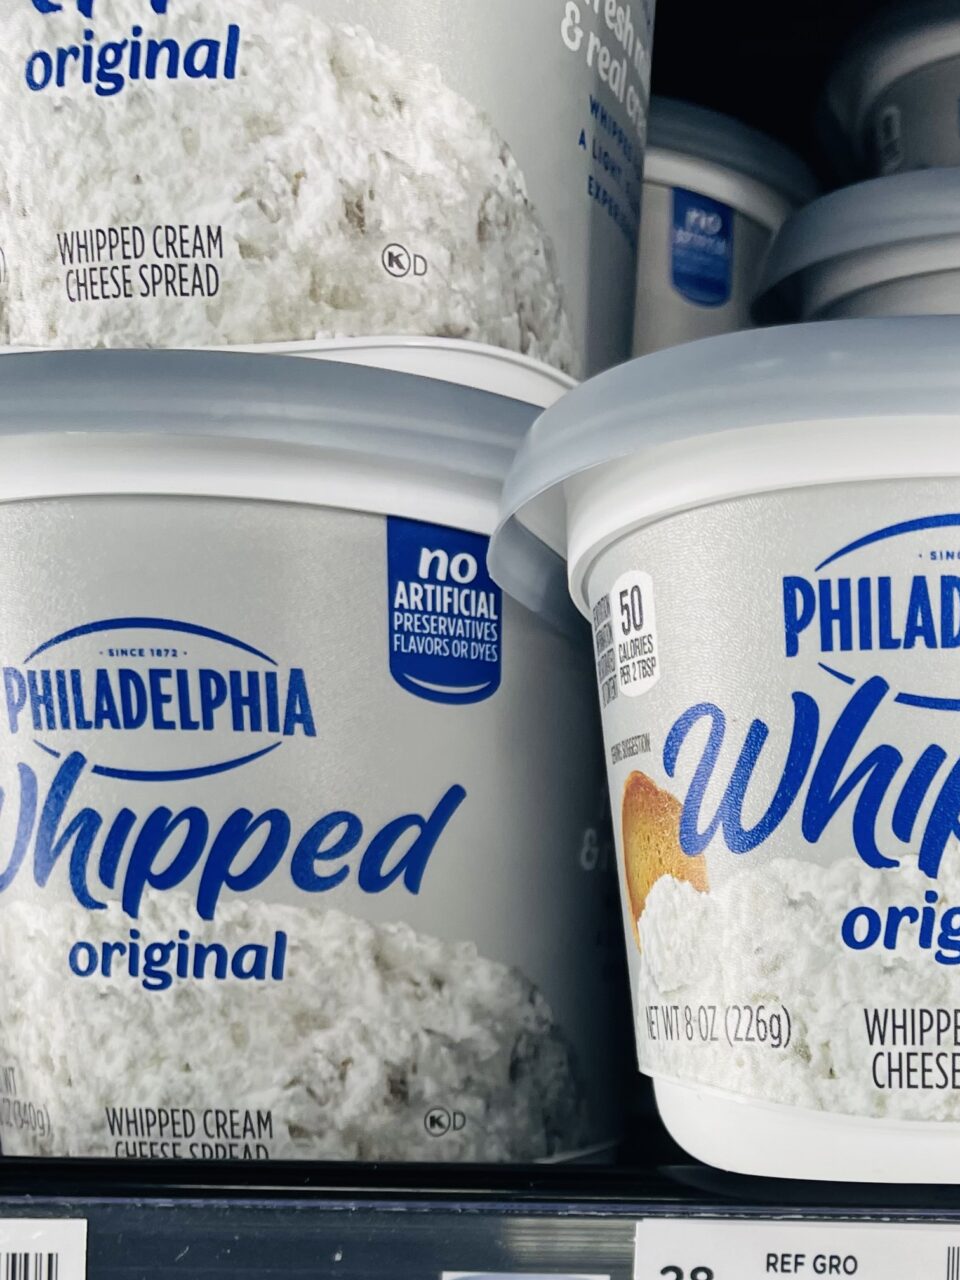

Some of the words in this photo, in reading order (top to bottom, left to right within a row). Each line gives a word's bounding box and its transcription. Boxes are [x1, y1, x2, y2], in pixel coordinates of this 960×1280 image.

[25, 24, 240, 97] original
[57, 226, 146, 267] WHIPPED
[152, 224, 224, 260] CREAM
[65, 265, 133, 302] CHEESE
[138, 263, 220, 299] SPREAD
[418, 547, 478, 584] no
[394, 581, 498, 620] ARTIFICIAL
[619, 585, 643, 635] 50
[394, 612, 498, 642] PRESERVATIVES
[108, 649, 145, 657] SINCE
[150, 649, 178, 657] 1872
[394, 634, 449, 657] FLAVORS
[452, 640, 469, 659] OR
[471, 643, 498, 662] DYES
[619, 634, 653, 663] CALORIES
[3, 666, 317, 737] PHILADELPHIA
[69, 931, 287, 990] original
[663, 1006, 680, 1041] WT
[684, 1005, 692, 1040] 8
[698, 1005, 719, 1042] OZ
[724, 1004, 791, 1048] (226g)
[106, 1108, 196, 1138] WHIPPED
[202, 1109, 273, 1140] CREAM
[766, 1253, 805, 1273] REF
[813, 1254, 858, 1275] GRO
